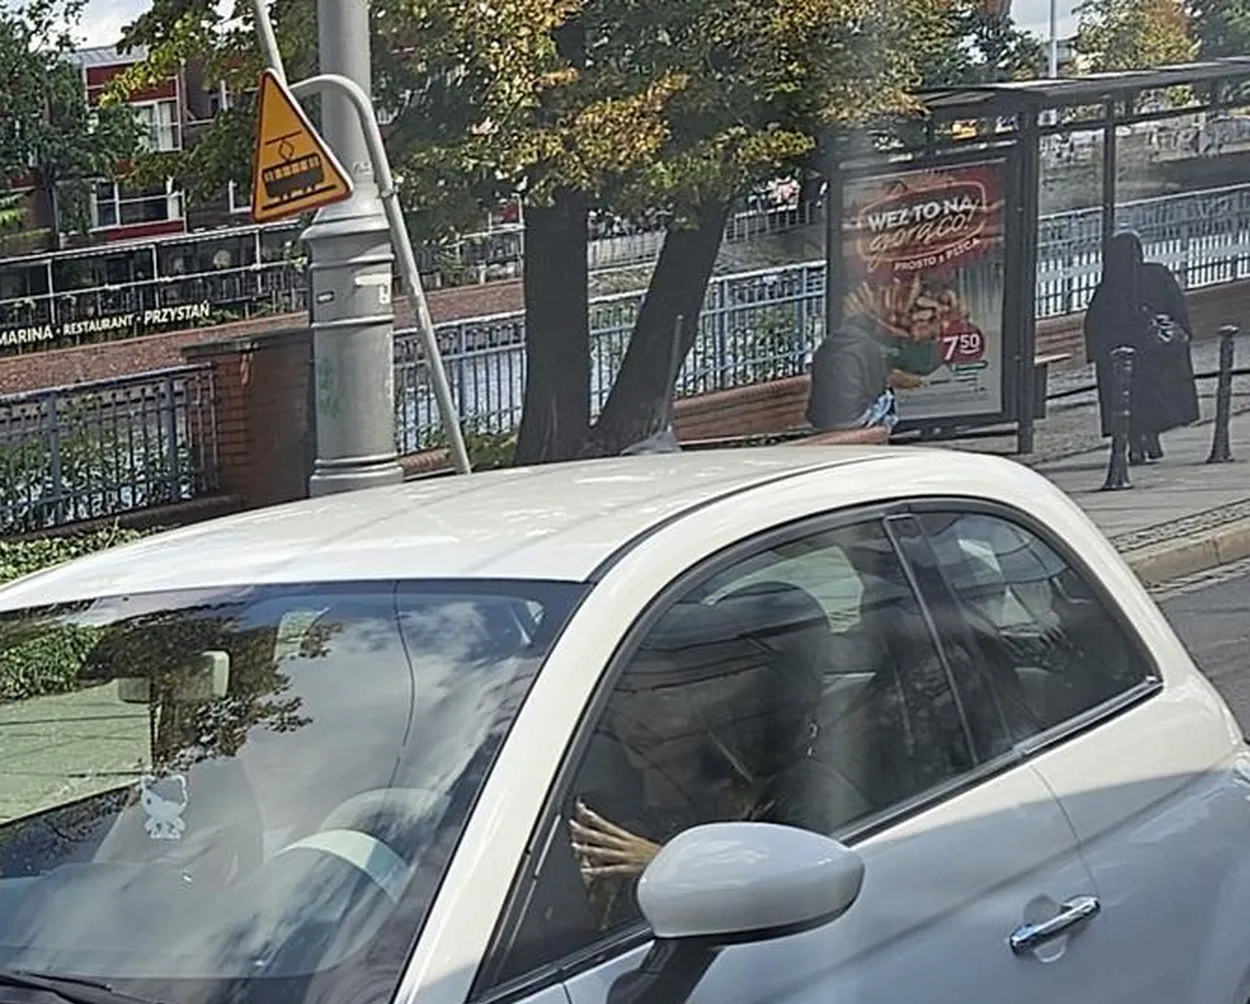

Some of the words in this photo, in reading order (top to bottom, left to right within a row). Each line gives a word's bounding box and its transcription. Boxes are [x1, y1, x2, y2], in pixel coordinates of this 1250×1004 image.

[912, 201, 941, 221] TO
[943, 195, 973, 214] NA
[894, 256, 938, 271] PROSTO
[62, 314, 135, 336] RESTAURANT
[143, 299, 210, 326] PRZYSTAŃ
